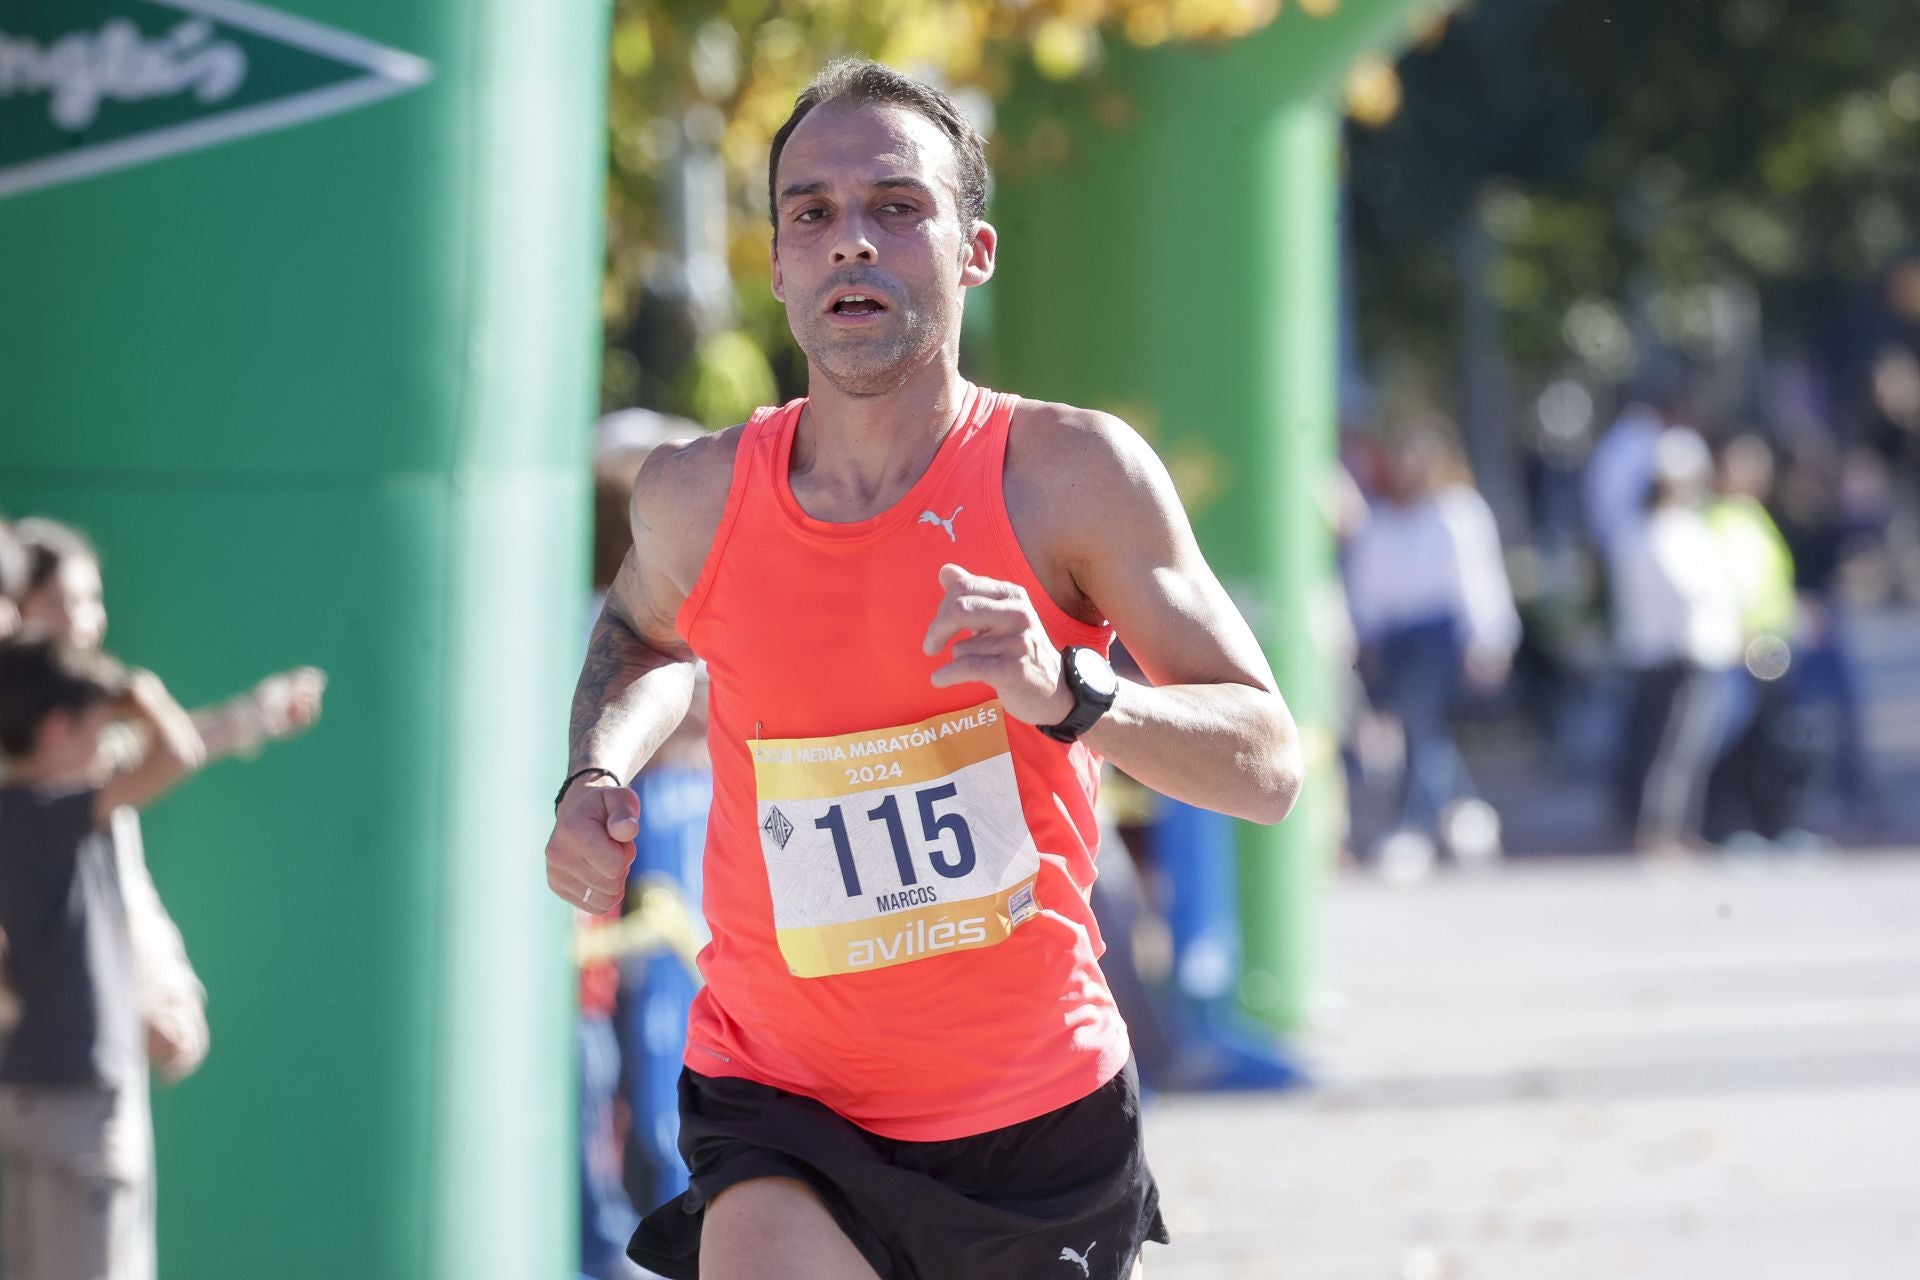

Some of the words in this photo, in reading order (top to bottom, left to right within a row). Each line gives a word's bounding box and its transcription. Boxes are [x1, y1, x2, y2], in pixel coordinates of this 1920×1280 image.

[797, 743, 847, 764] MEDIA
[849, 728, 937, 759] MARATÓN
[941, 708, 998, 737] AVILÉS
[845, 761, 903, 785] 2024
[814, 782, 977, 897] 115
[876, 886, 938, 913] MARCOS
[847, 916, 986, 967] avilés
